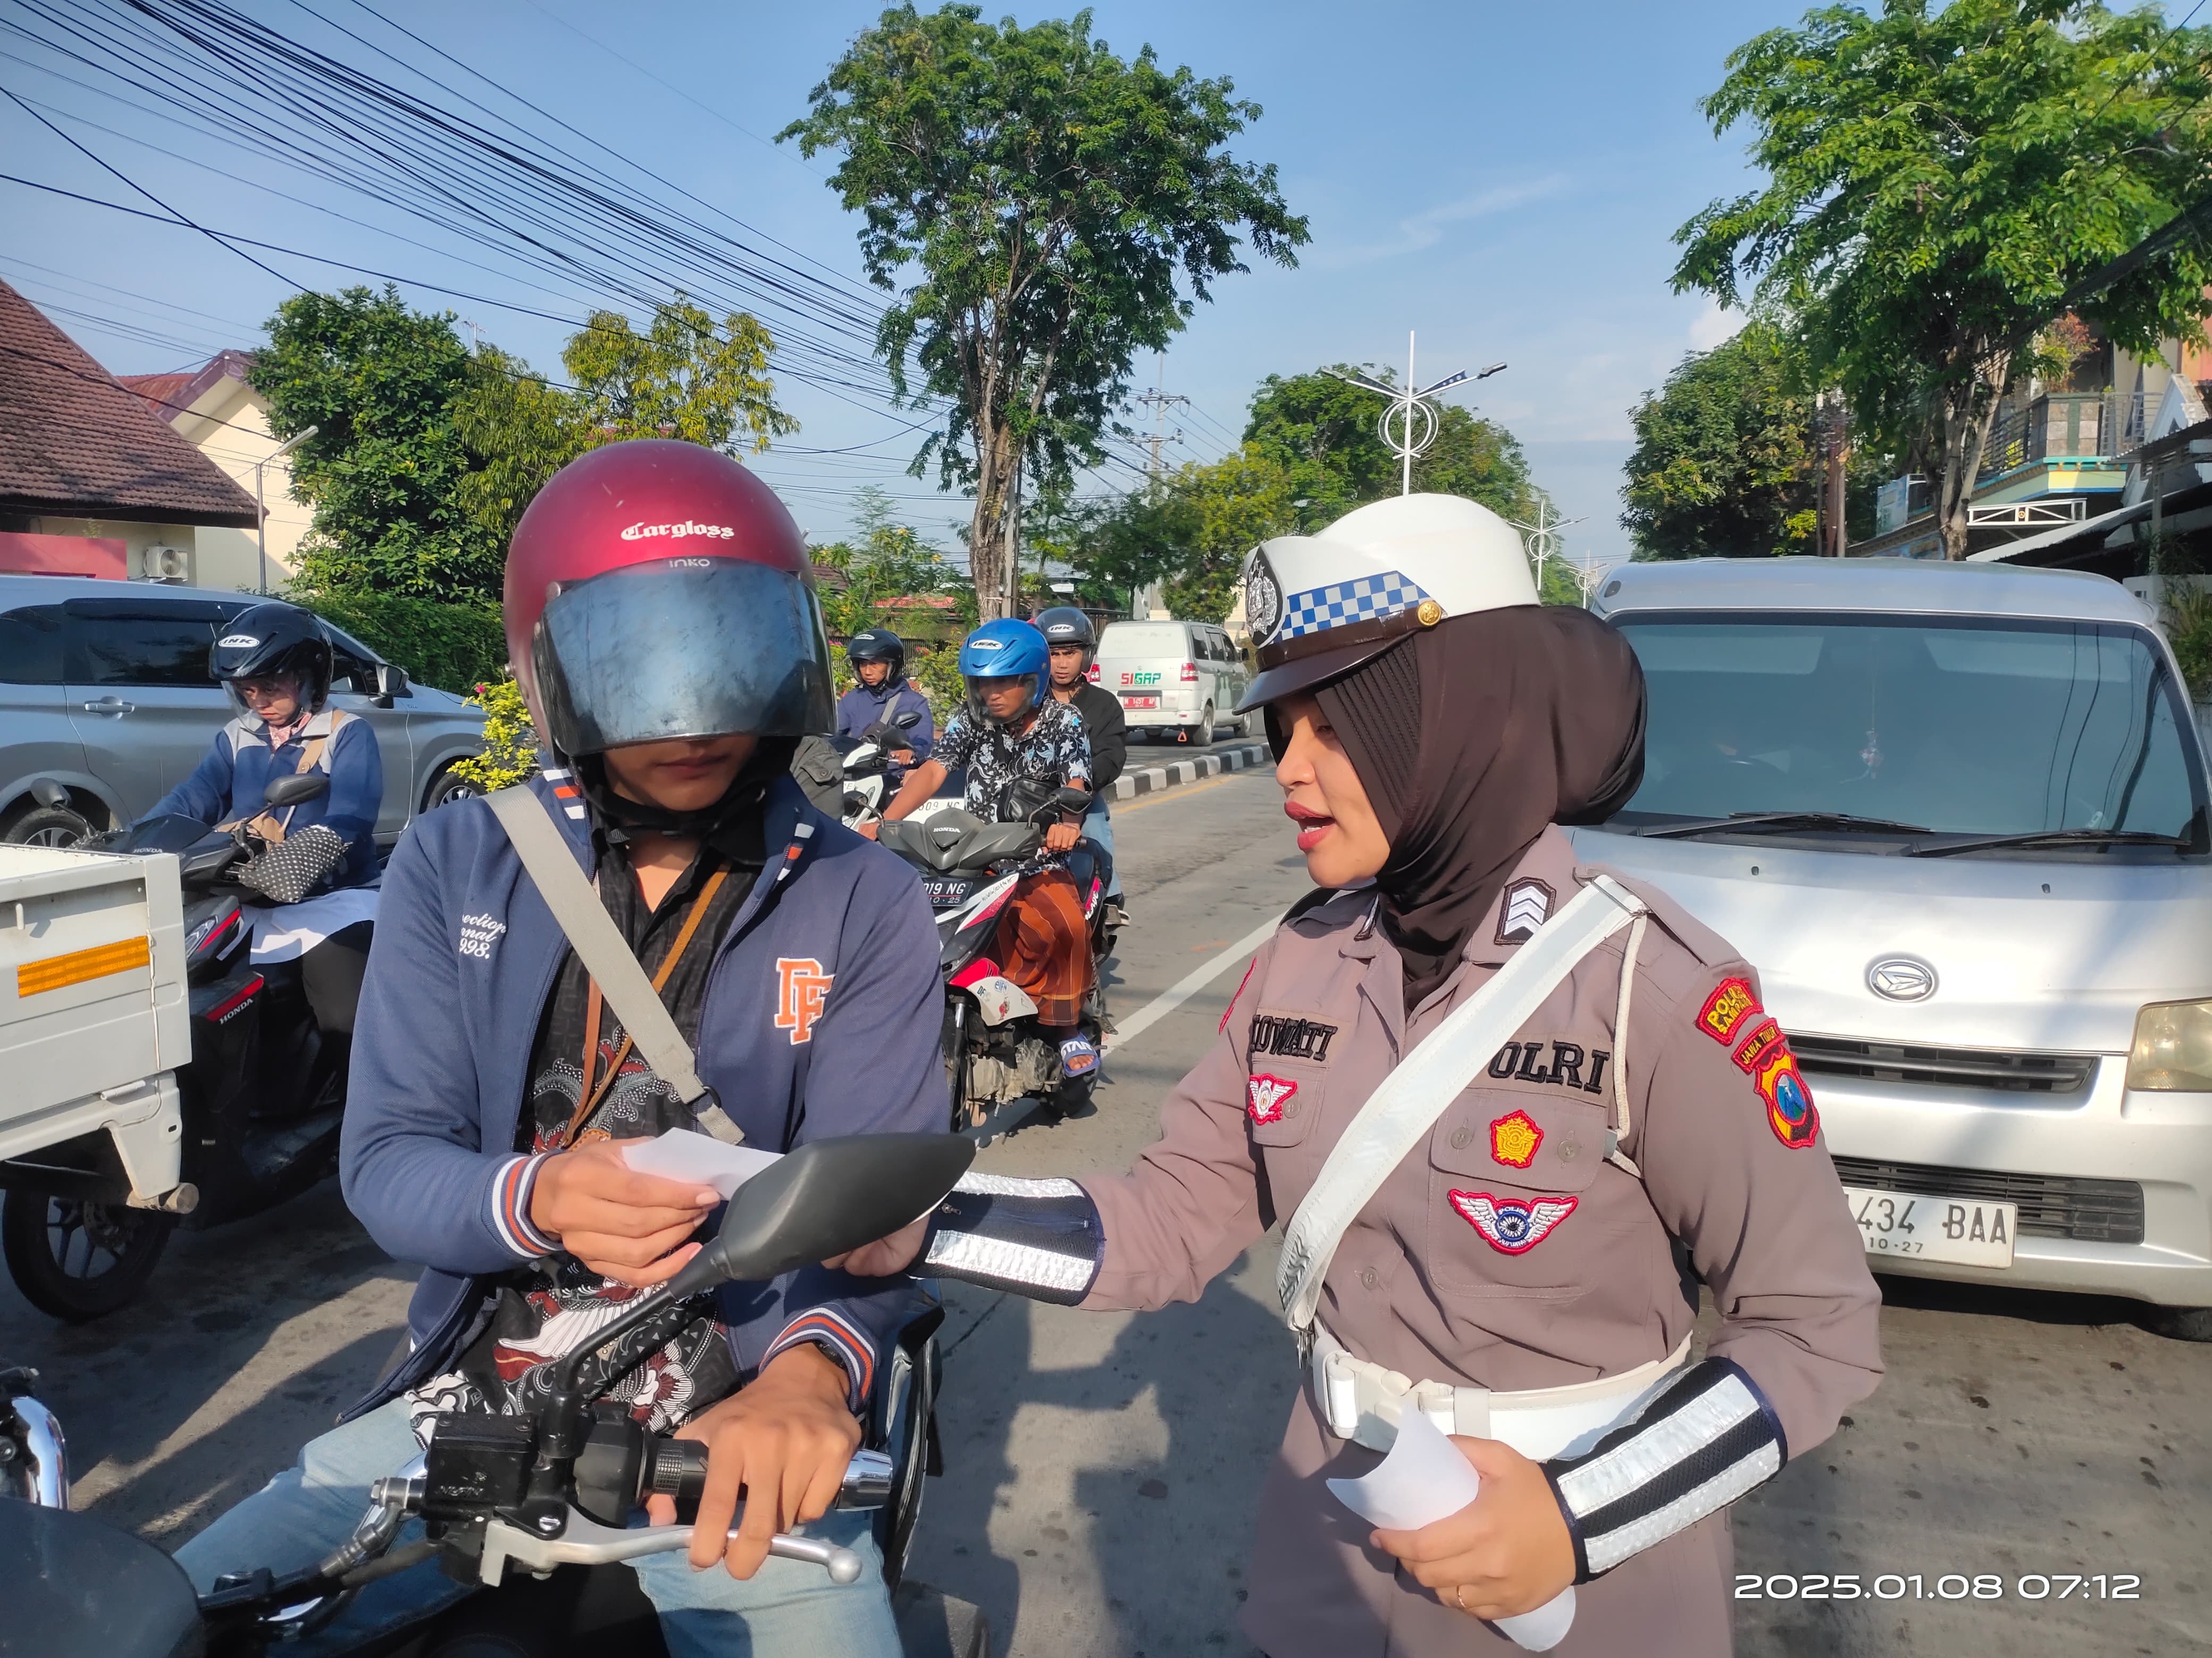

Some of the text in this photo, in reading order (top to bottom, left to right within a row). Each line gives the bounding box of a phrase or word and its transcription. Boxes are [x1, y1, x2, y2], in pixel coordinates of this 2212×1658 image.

[621, 520, 735, 541] Cargloss
[1120, 672, 1161, 685] SIGAP
[946, 882, 966, 895] NG
[462, 913, 506, 933] ection
[219, 998, 254, 1025] HONDA
[1846, 1194, 2007, 1244] 434 BAA
